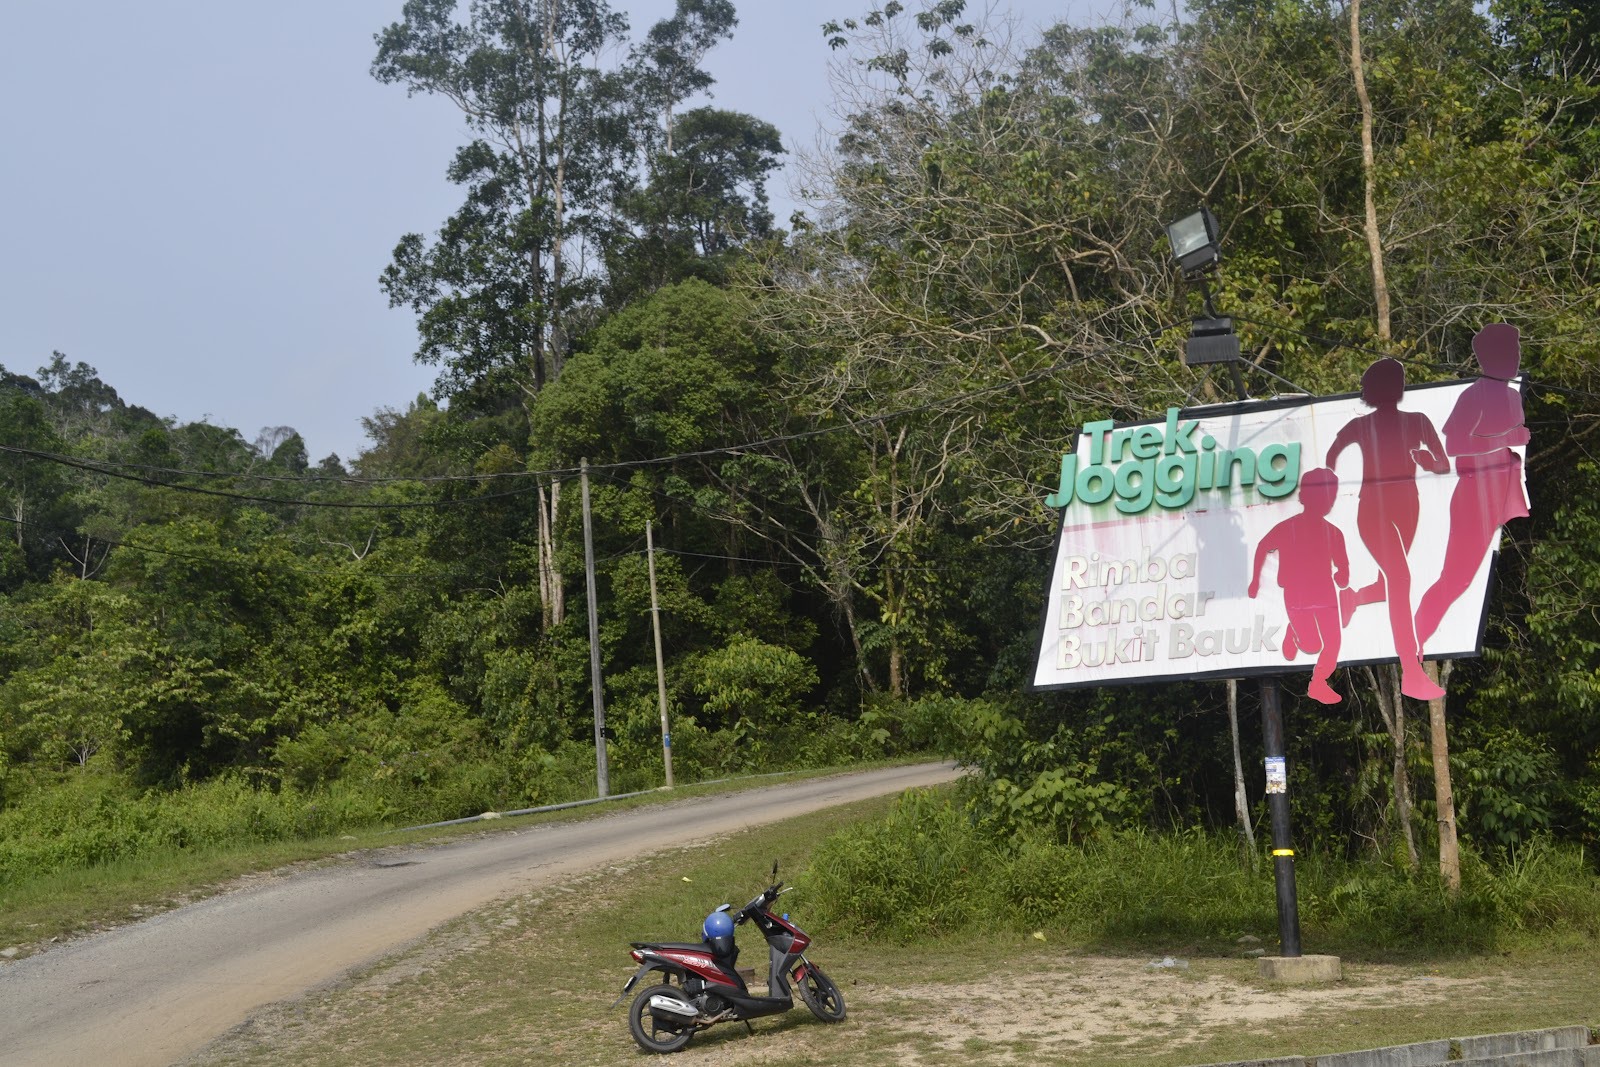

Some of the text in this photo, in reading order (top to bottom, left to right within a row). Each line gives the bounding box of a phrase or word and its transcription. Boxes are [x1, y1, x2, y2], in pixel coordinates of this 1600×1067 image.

[1083, 408, 1199, 465] Trek
[1046, 438, 1301, 513] Jogging
[1061, 547, 1196, 590] Rimba
[1059, 584, 1214, 629] Bandar
[1057, 615, 1279, 670] Bukit Bauk
